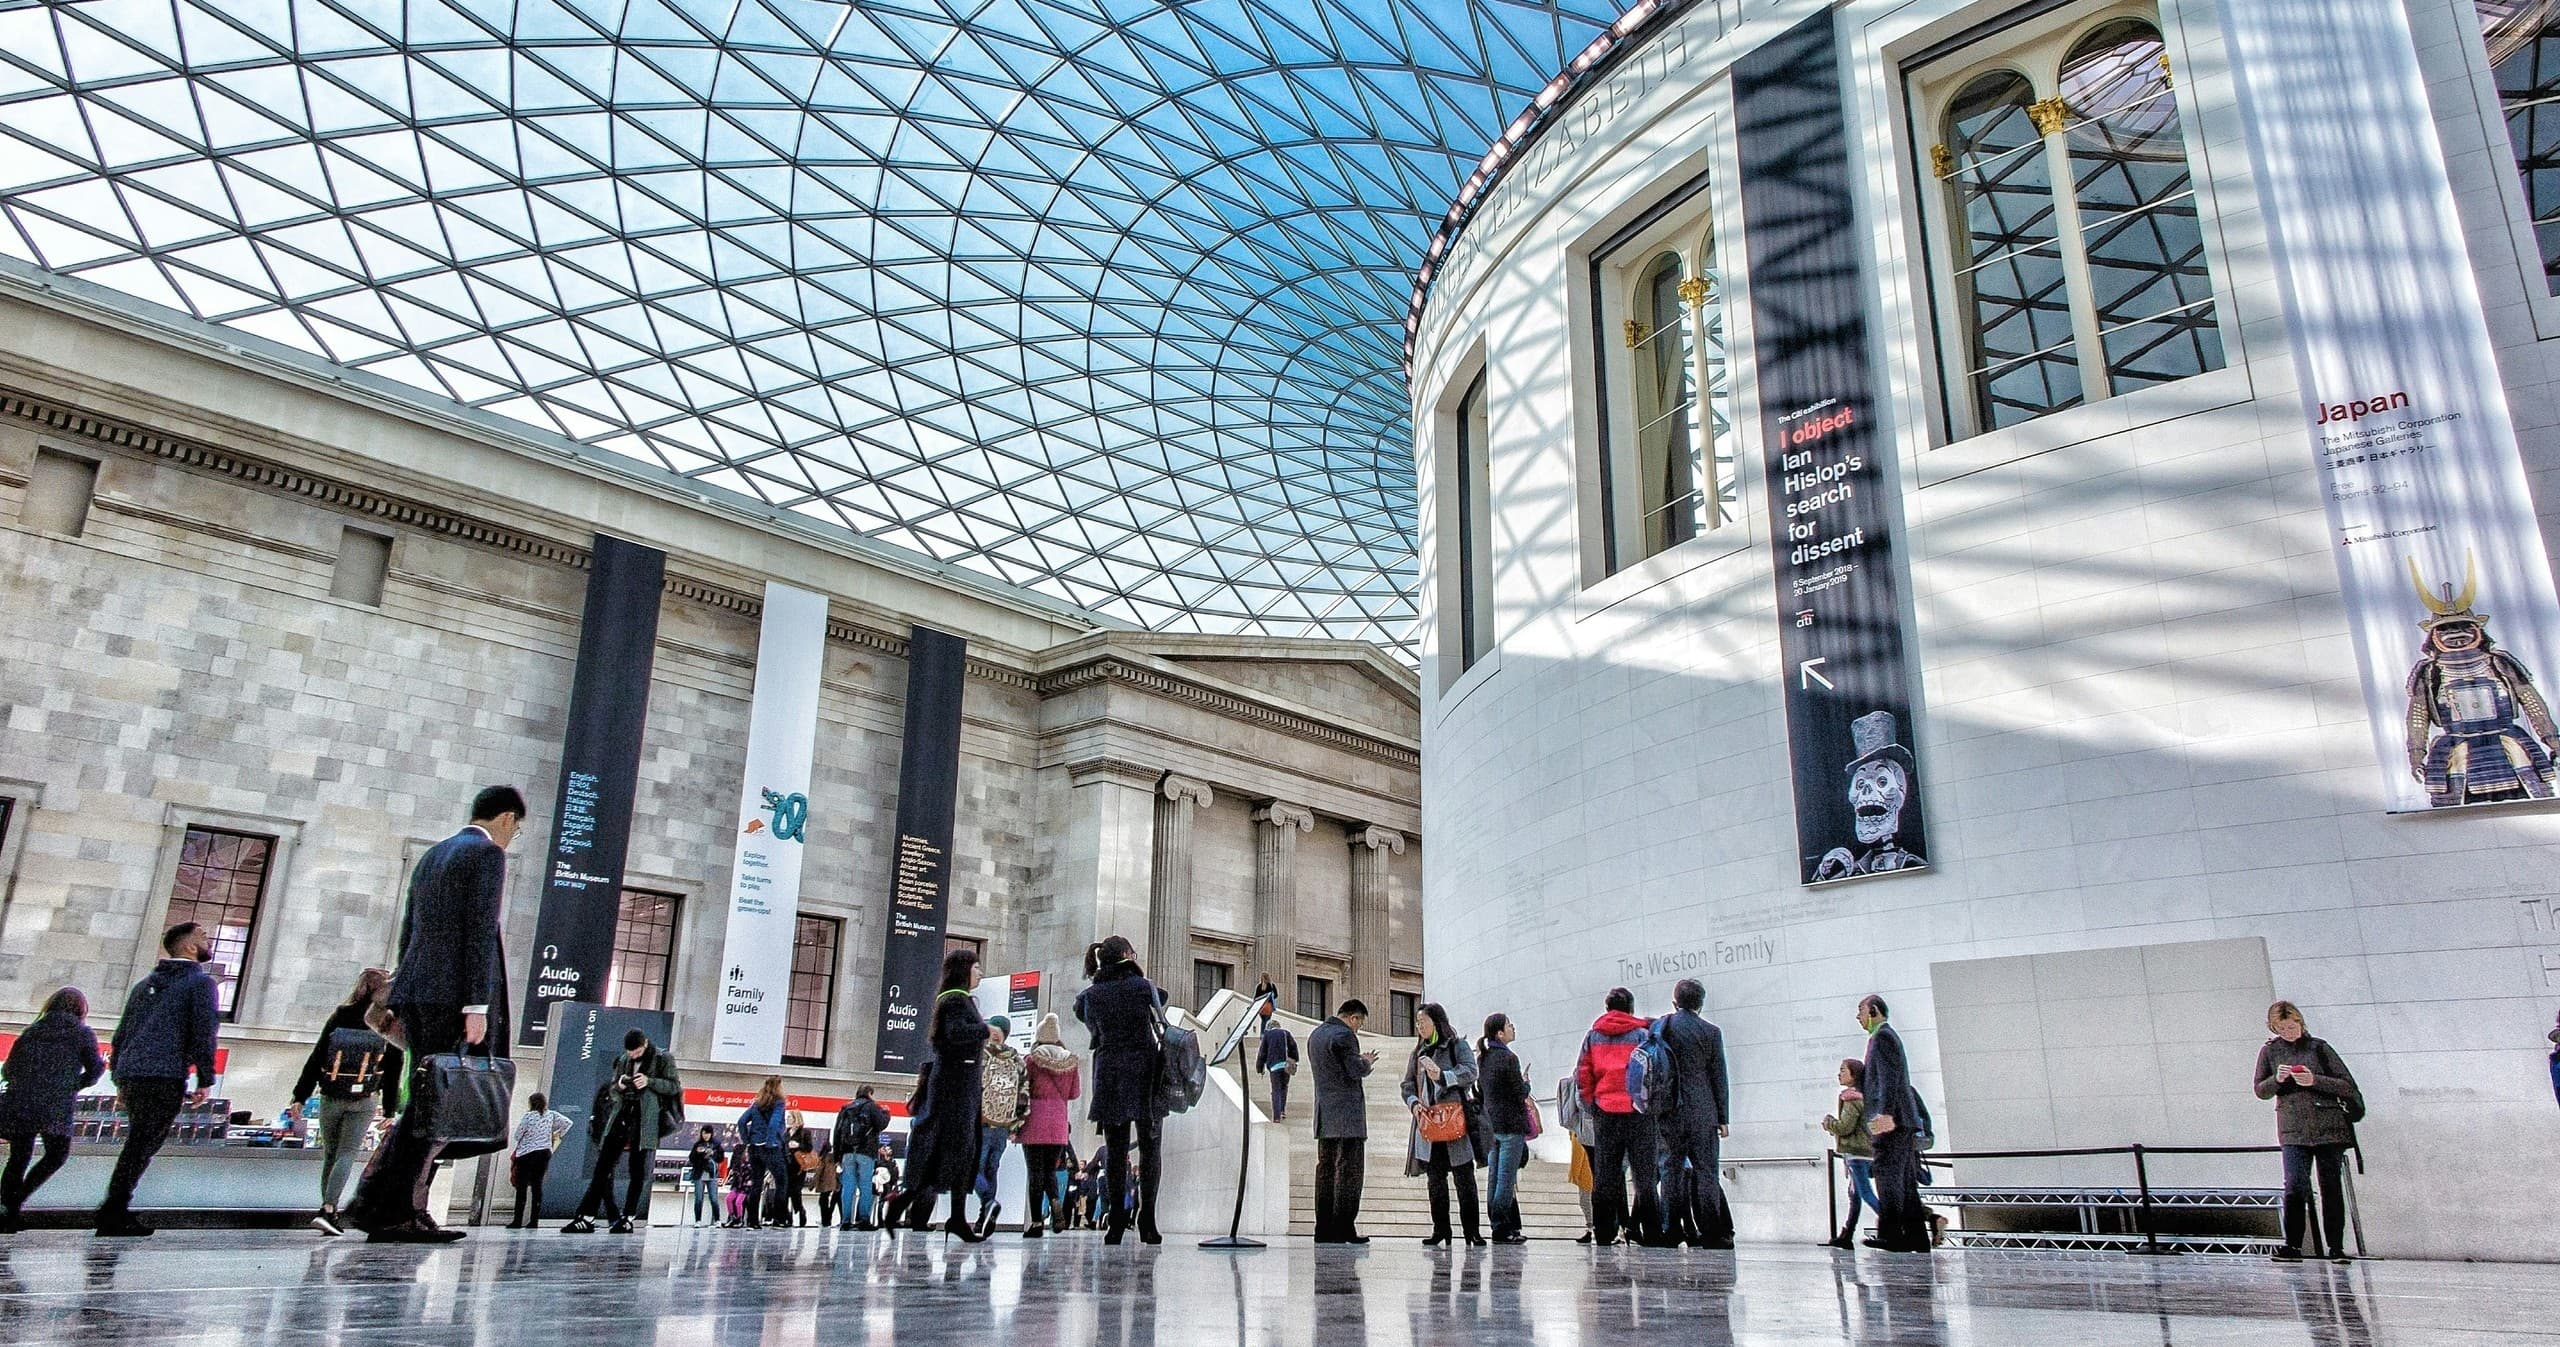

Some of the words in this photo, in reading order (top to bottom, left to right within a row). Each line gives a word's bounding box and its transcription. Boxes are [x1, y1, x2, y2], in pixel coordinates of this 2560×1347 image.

[1490, 16, 1695, 236] ELIZABETH
[1778, 416, 1790, 424] The
[1803, 398, 1836, 414] exhibition
[2317, 392, 2409, 424] Japan
[1781, 430, 1786, 448] I
[1792, 407, 1854, 444] object
[2320, 436, 2340, 446] The
[2343, 426, 2396, 441] Mitsubishi
[2398, 412, 2461, 430] Corporation
[2323, 440, 2373, 456] Japanese
[2376, 431, 2423, 445] Galleries
[1783, 450, 1812, 471] Ian
[2330, 481, 2354, 491] Free
[1787, 483, 1852, 517] search
[2332, 488, 2369, 502] Rooms
[1788, 521, 1816, 541] for
[1791, 527, 1864, 565] dissent
[1793, 580, 1798, 588] 6
[1798, 572, 1833, 586] September
[1835, 565, 1853, 575] 2018
[1794, 588, 1803, 596] 20
[1804, 581, 1830, 594] January
[1830, 575, 1847, 586] 2019
[1796, 614, 1814, 628] citi
[744, 851, 766, 860] Explore
[557, 861, 570, 870] The
[555, 870, 578, 879] British
[580, 873, 609, 883] Museum
[742, 874, 755, 882] Take
[571, 881, 586, 889] way
[896, 920, 912, 928] British
[913, 922, 935, 931] Museum
[1617, 959, 1644, 982] The
[1648, 952, 1709, 976] Weston
[1714, 935, 1775, 969] Family
[540, 966, 580, 982] Audio
[538, 984, 577, 997] guide
[728, 986, 764, 1002] Family
[589, 1009, 597, 1022] on
[726, 1002, 758, 1014] guide
[888, 1003, 918, 1016] Audio
[887, 1018, 915, 1030] guide
[706, 1095, 725, 1103] Audio
[726, 1096, 742, 1104] guide
